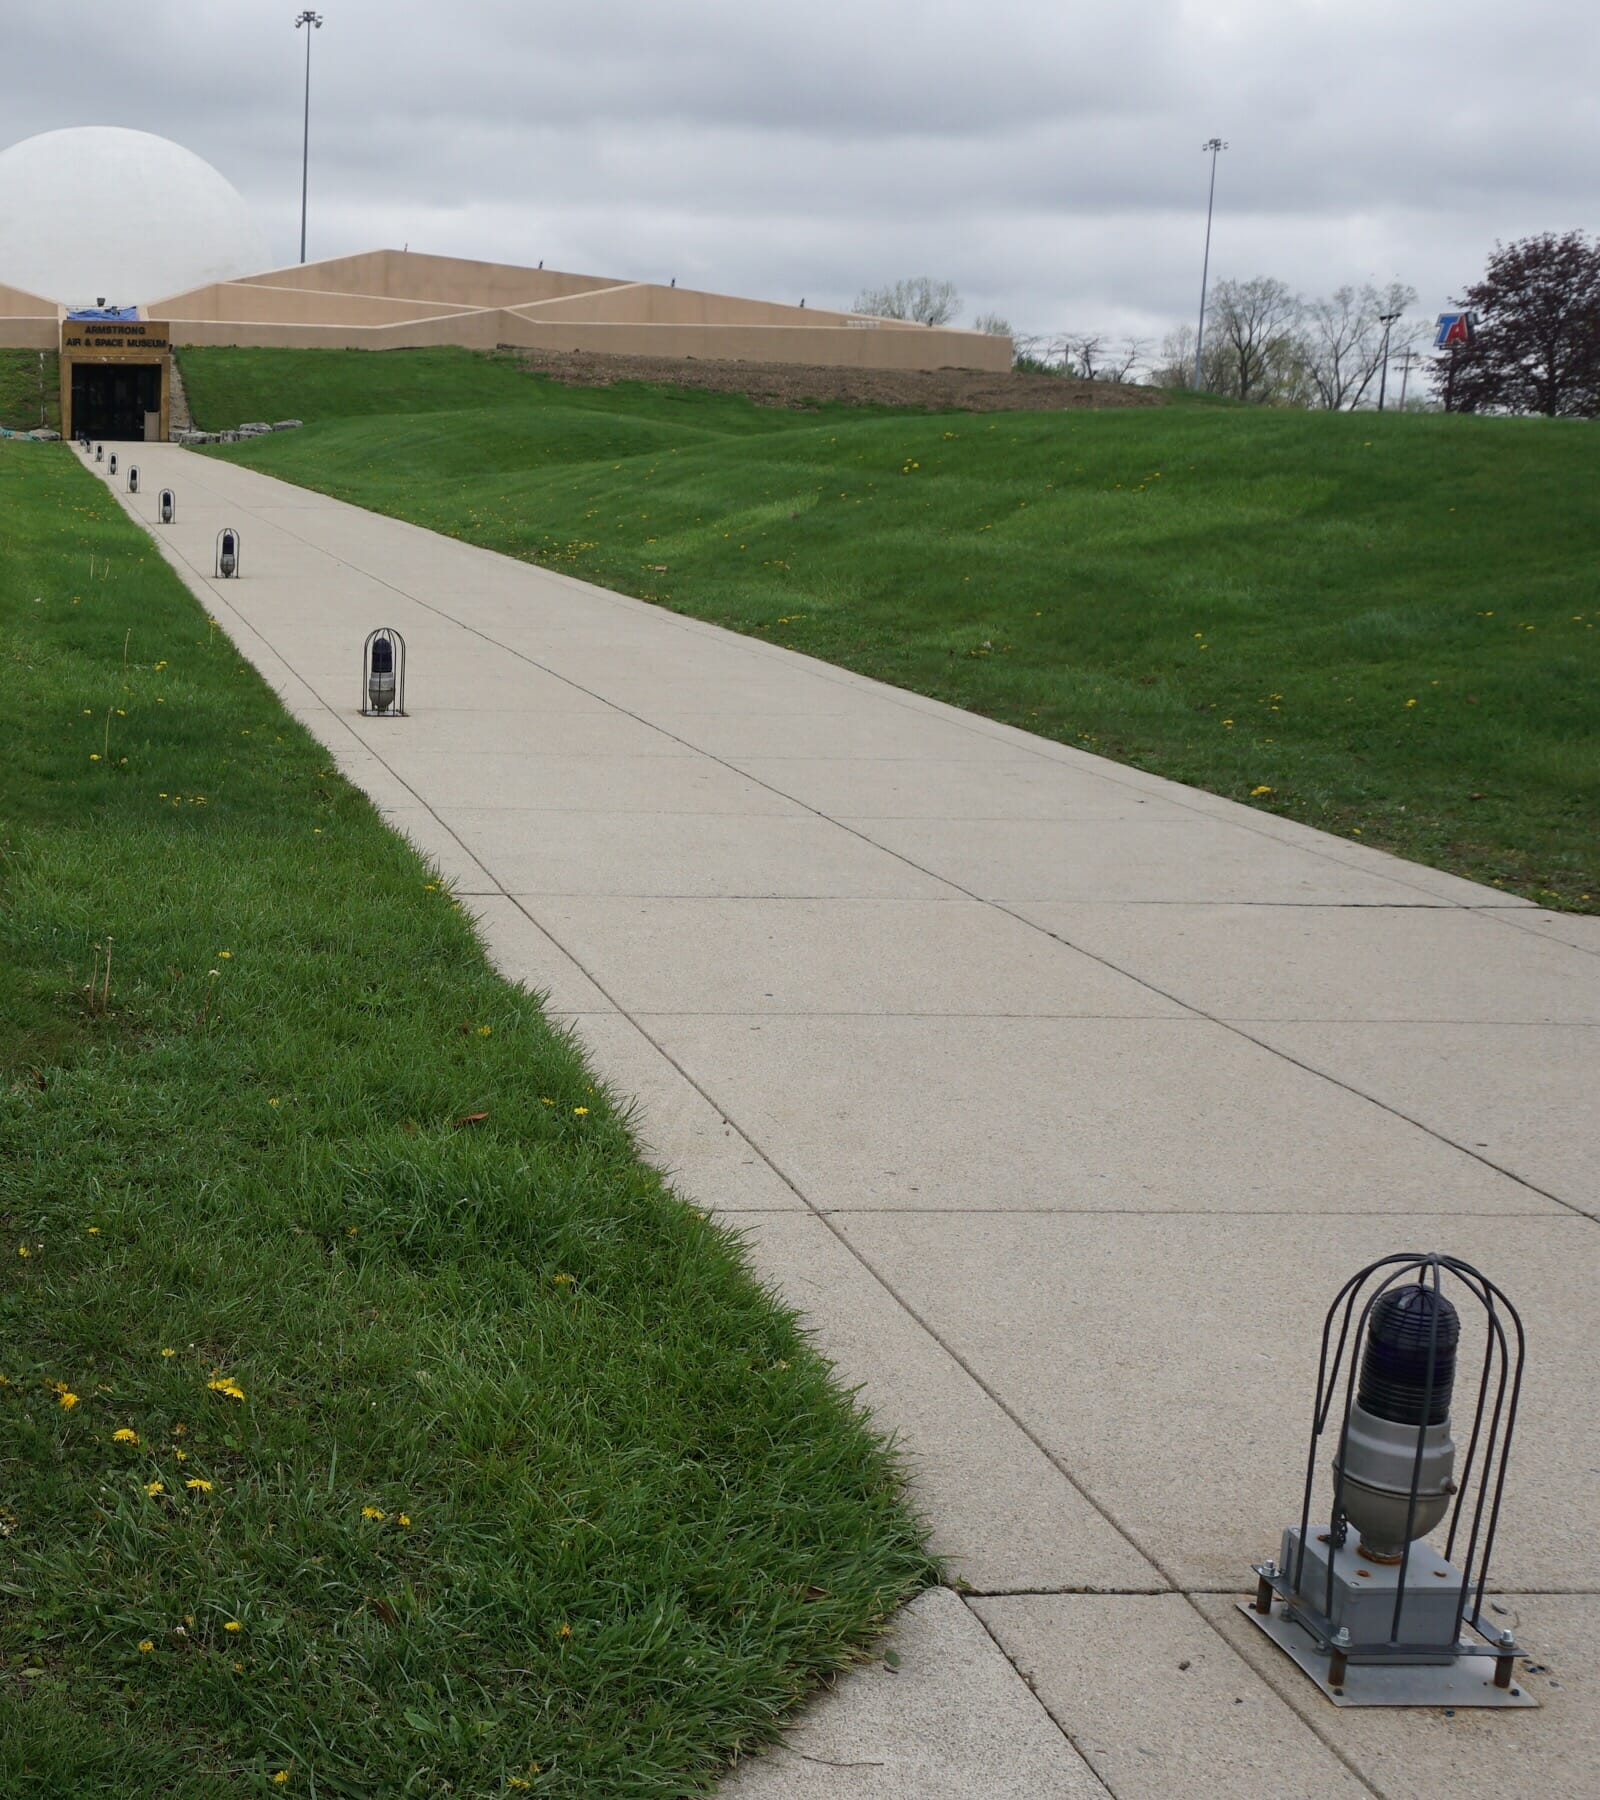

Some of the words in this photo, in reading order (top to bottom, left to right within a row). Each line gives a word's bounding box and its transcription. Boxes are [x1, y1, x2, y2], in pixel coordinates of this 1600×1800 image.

[84, 325, 146, 335] ARMSTRONG
[1434, 313, 1469, 346] TA
[65, 337, 82, 346] AIR
[84, 338, 92, 347] &
[94, 338, 123, 347] SPACE
[126, 338, 167, 348] MUSEUM
